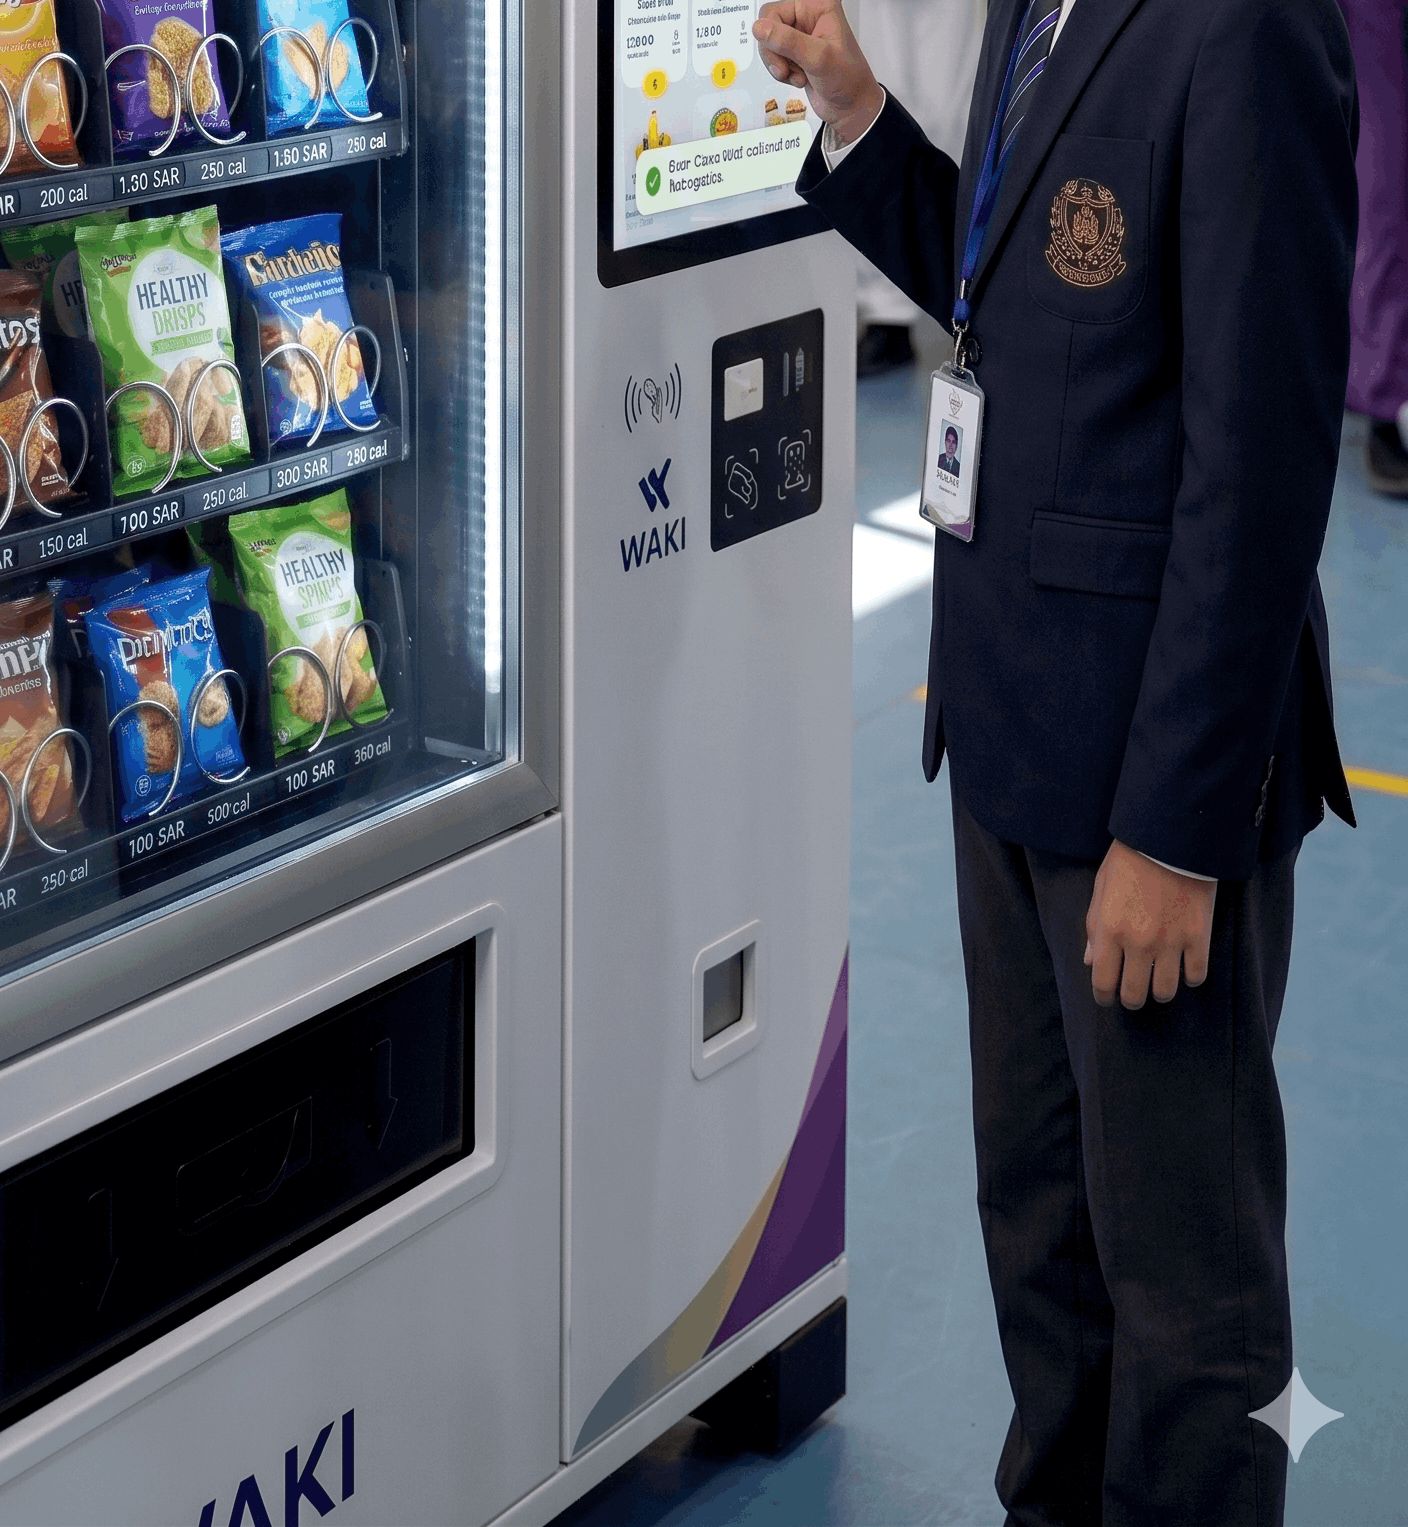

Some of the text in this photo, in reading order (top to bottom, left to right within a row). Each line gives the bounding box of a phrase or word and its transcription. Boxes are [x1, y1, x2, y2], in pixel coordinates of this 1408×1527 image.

[303, 142, 327, 161] SAR
[347, 132, 387, 154] 250 cal
[153, 167, 180, 188] SAR
[201, 157, 246, 180] 250 cal
[40, 183, 88, 208] 200 cal
[136, 272, 209, 310] HEALTHY
[152, 302, 206, 335] DRISPS
[277, 457, 328, 488] 300 SAR
[152, 501, 179, 525] SAR
[203, 489, 225, 510] 250
[39, 527, 88, 558] 150 cal
[620, 516, 686, 572] WAKI
[280, 548, 346, 587] HEALTHY
[354, 735, 391, 765] 360 cal
[285, 759, 335, 793] 100 SAR
[232, 792, 250, 815] cal
[129, 820, 185, 859] 100 SAR
[69, 858, 88, 882] cal
[198, 1408, 355, 1527] AKI
